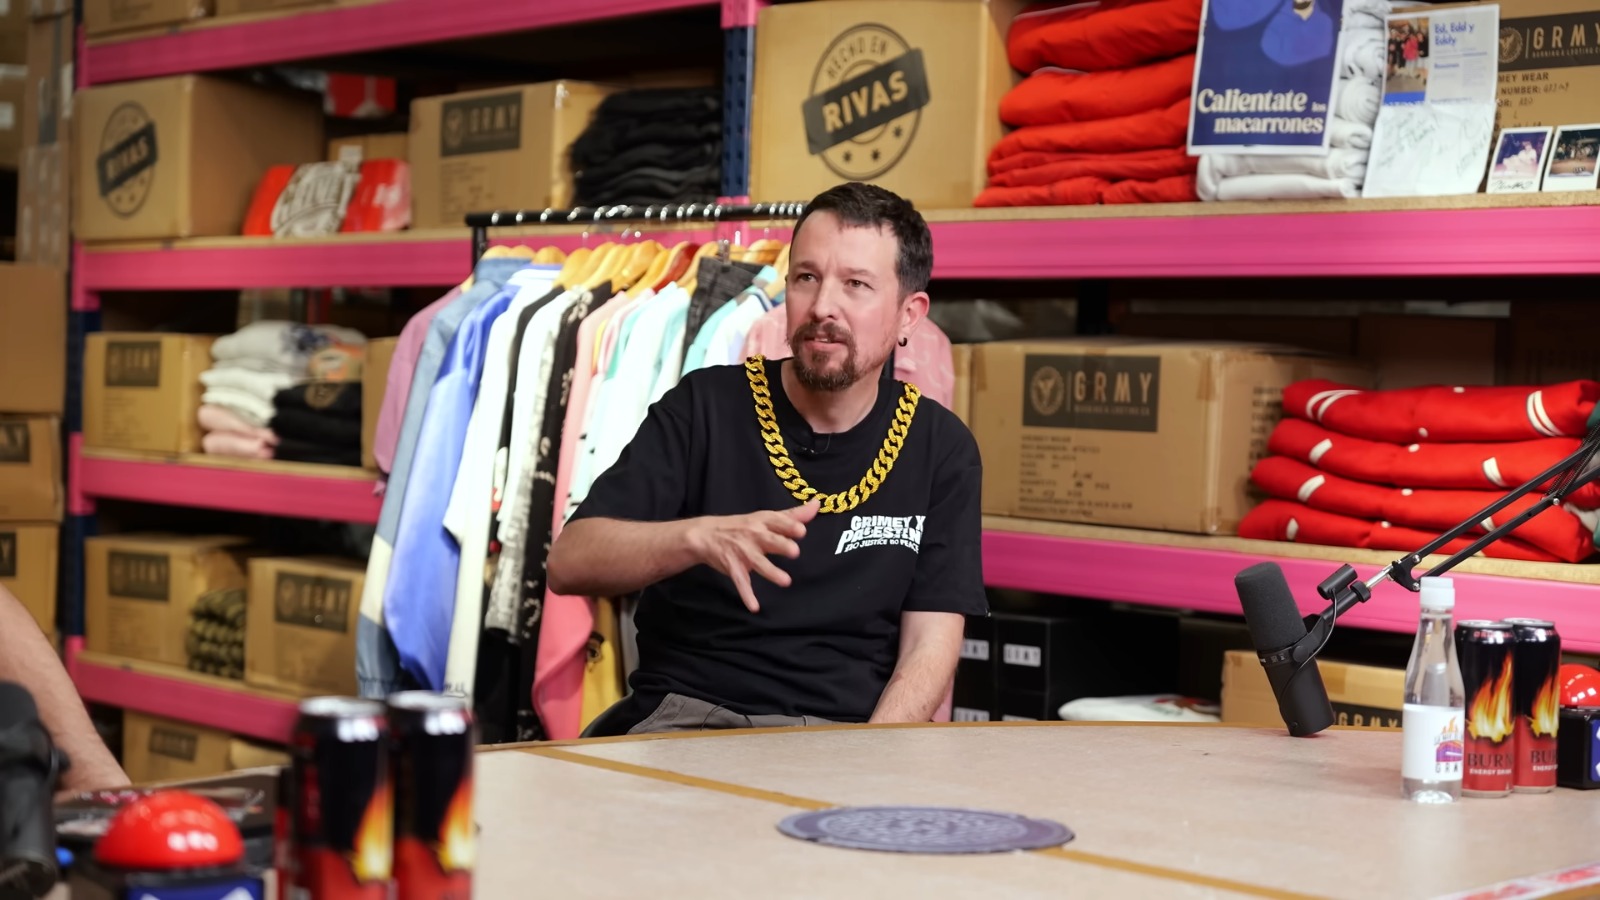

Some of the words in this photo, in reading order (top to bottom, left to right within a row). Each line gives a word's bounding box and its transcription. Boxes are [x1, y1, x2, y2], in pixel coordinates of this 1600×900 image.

[1521, 72, 1549, 82] WEAR
[1501, 85, 1542, 96] NUMBER:
[822, 70, 909, 133] RIVAS
[1198, 88, 1308, 113] Calientate
[1213, 117, 1324, 134] macarrones
[1074, 370, 1153, 404] GRMY
[850, 515, 913, 531] GRIMEY
[915, 515, 926, 533] X
[834, 526, 922, 555] PALESTIN
[860, 539, 888, 548] JUSTICE
[1468, 752, 1513, 768] BURN
